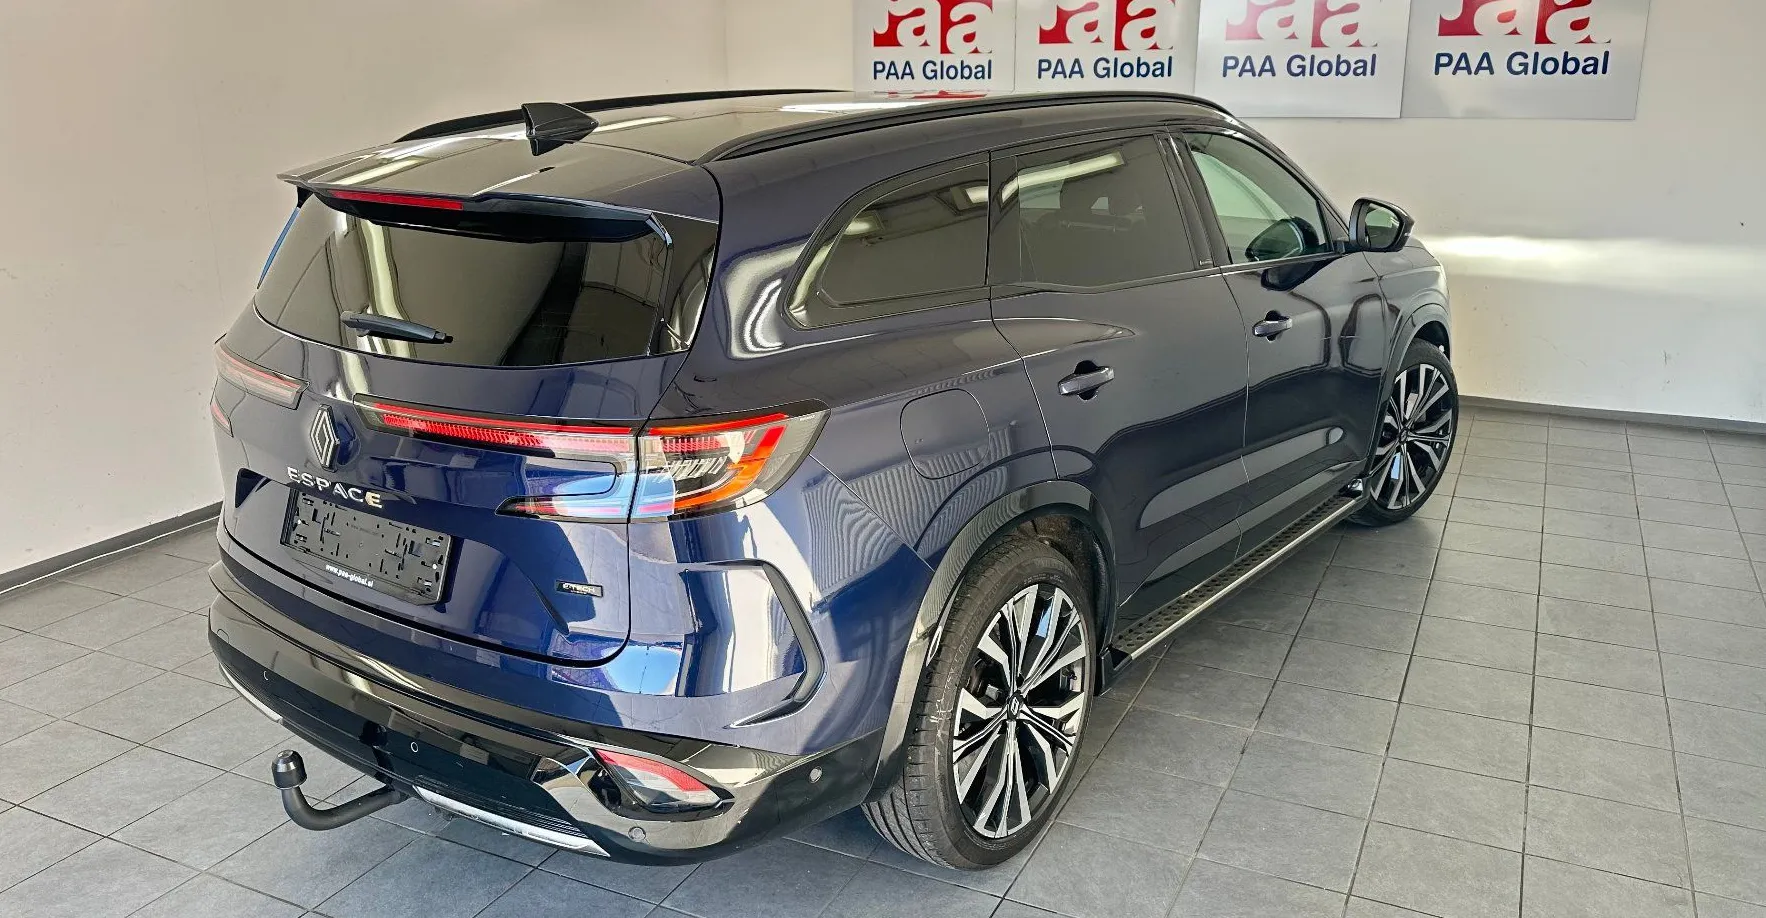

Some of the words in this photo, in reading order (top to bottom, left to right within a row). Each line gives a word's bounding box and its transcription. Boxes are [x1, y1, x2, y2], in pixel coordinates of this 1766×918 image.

[873, 60, 915, 81] PAA
[922, 59, 992, 81] Global
[1037, 58, 1085, 80] PAA
[1092, 55, 1173, 79] Global
[1222, 54, 1277, 78] PAA
[1286, 53, 1377, 78] Global
[1434, 51, 1495, 76] PAA
[1506, 50, 1610, 76] Global
[287, 466, 383, 509] ESPACE
